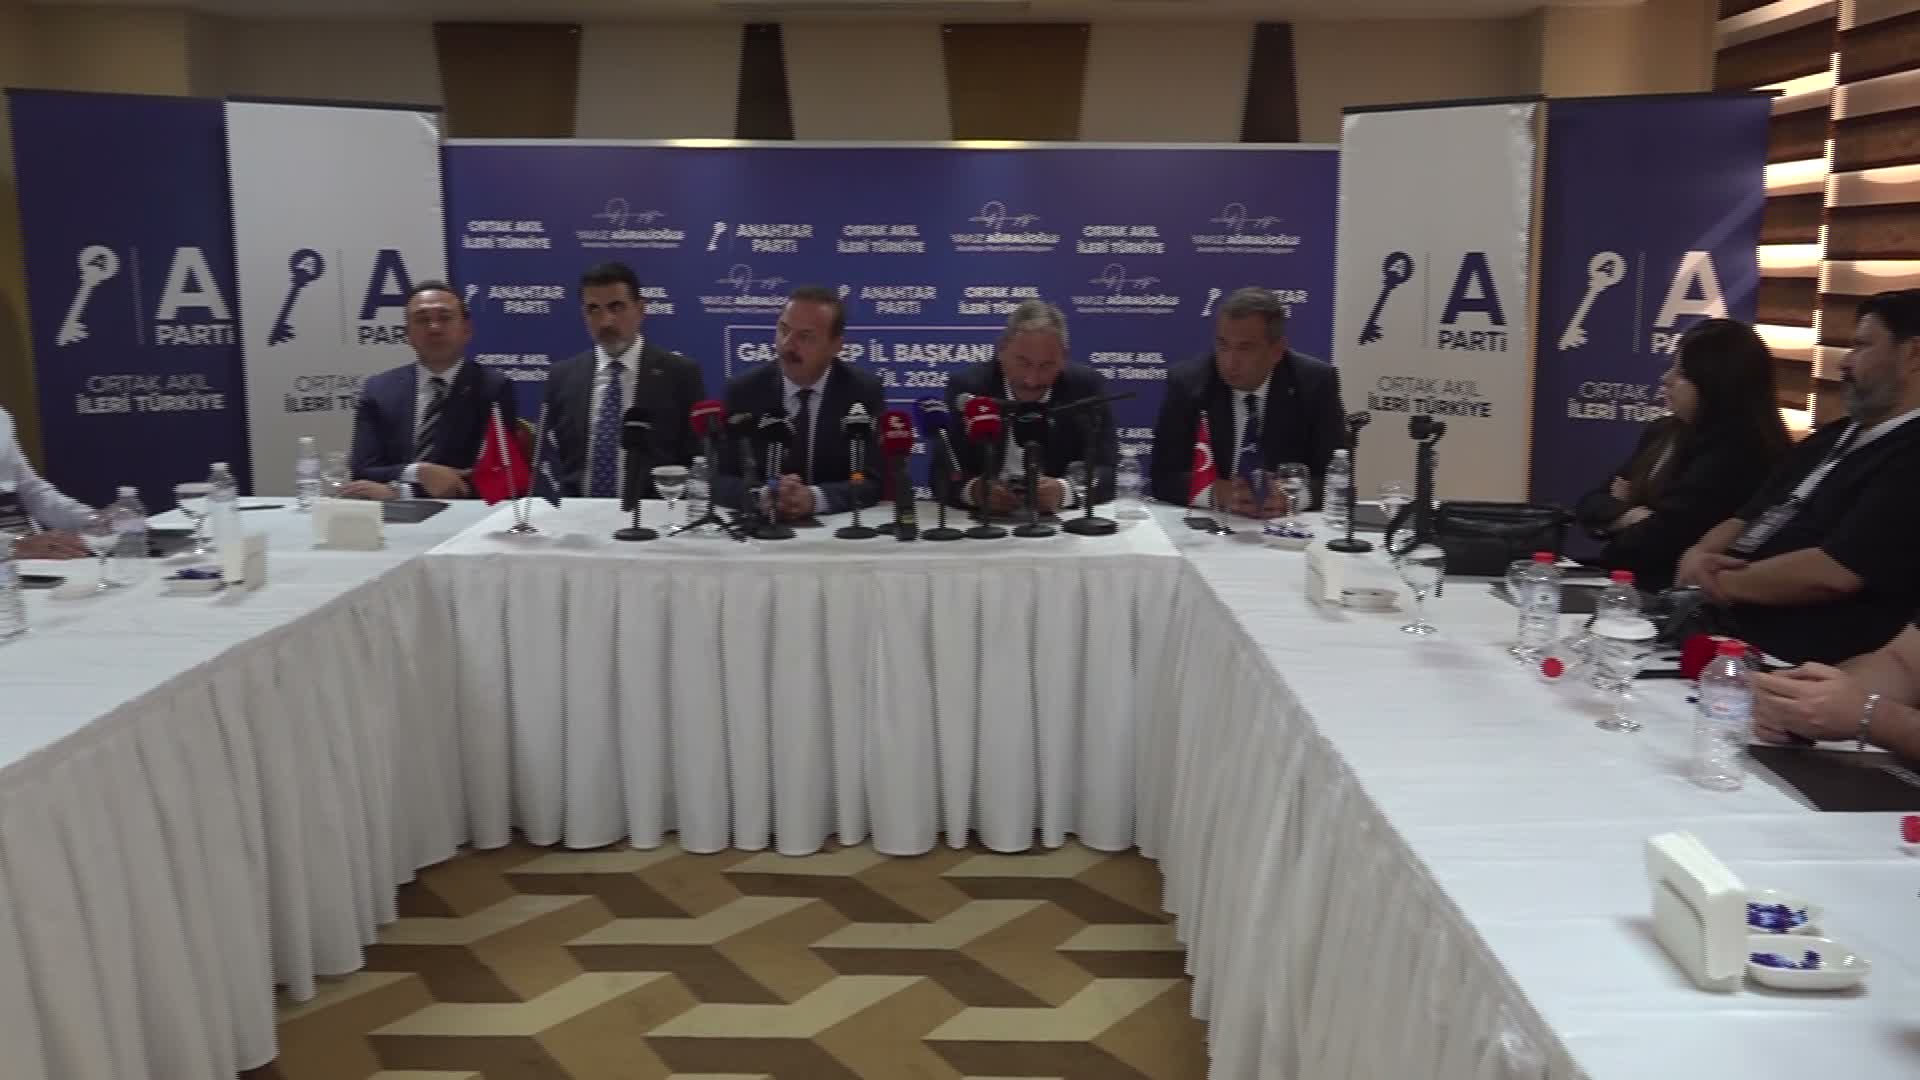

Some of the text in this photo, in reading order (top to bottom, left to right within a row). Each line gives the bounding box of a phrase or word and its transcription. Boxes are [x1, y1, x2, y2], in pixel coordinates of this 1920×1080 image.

[467, 220, 545, 234] ORTAK AKIL
[735, 223, 814, 239] ANAHTAR
[842, 225, 920, 238] ORTAK AKIL
[1082, 225, 1160, 239] ORTAK AKIL
[461, 235, 552, 249] İLERİ TÜRKİYE
[575, 230, 610, 241] YAVUZ
[949, 234, 985, 245] YAVUZ
[1191, 235, 1226, 246] YAVUZ
[836, 239, 926, 254] İLERİ TÜRKİYE
[1076, 240, 1165, 256] İLERİ TÜRKİYE
[154, 247, 233, 322] A
[356, 249, 418, 322] A
[487, 285, 565, 300] ANAHTAR
[1439, 251, 1508, 326] A
[1653, 250, 1732, 329] A
[698, 295, 733, 306] YAVUZ
[859, 286, 938, 301] ANAHTAR
[963, 287, 1041, 300] ORTAK AKIL
[1071, 296, 1107, 307] YAVUZ
[958, 300, 993, 316] İLERİ
[357, 324, 409, 347] PAR
[869, 338, 893, 363] İL
[1089, 352, 1166, 365] ORTAK AKIL
[474, 353, 552, 366] ORTAK AKIL
[85, 373, 212, 393] ORTAK AKIL
[1375, 376, 1482, 398] ORTAK AKIL
[1578, 381, 1651, 404] ORTAK
[75, 391, 226, 416] İLERİ TÜRKİYE
[283, 393, 334, 414] İLERİ
[1367, 391, 1492, 419] İLERİ TÜRKİYE
[1567, 397, 1618, 422] İLERİ
